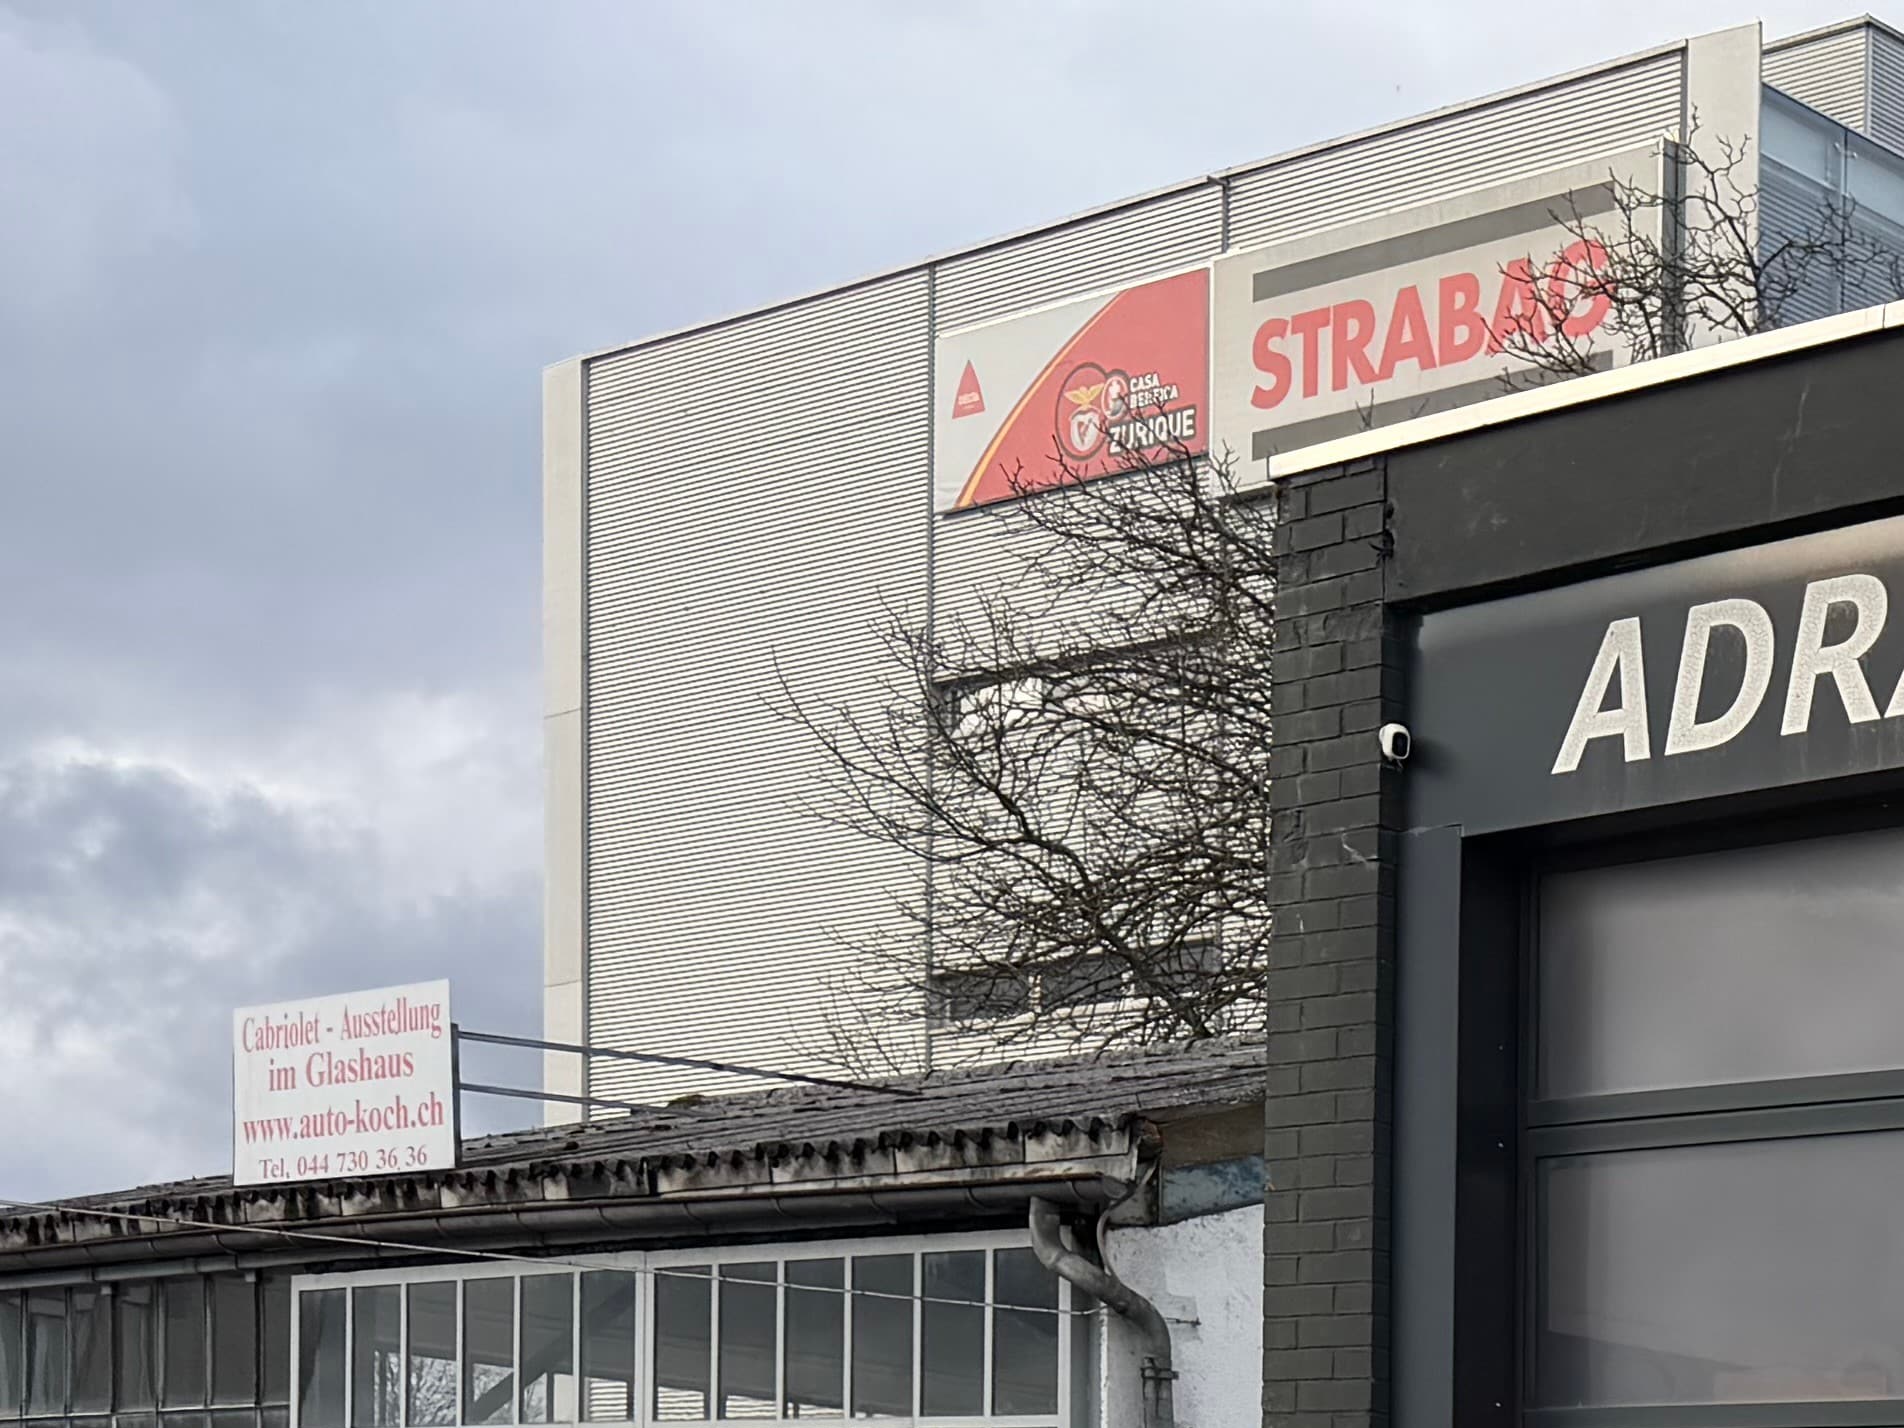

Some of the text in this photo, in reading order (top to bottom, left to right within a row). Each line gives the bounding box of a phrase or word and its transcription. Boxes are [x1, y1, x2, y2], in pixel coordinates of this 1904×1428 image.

[1251, 237, 1613, 410] STRABAG
[1130, 372, 1160, 390] CASA
[1108, 408, 1195, 454] ZURIQUE
[242, 1011, 320, 1053] Cabriolet
[340, 996, 442, 1039] Ausstellung
[268, 1047, 414, 1092] im Glashaus
[243, 1091, 444, 1145] www.auto-koch.ch
[297, 1153, 329, 1177] 044
[336, 1150, 369, 1173] 730
[376, 1147, 398, 1169] 36
[405, 1144, 427, 1166] 36
